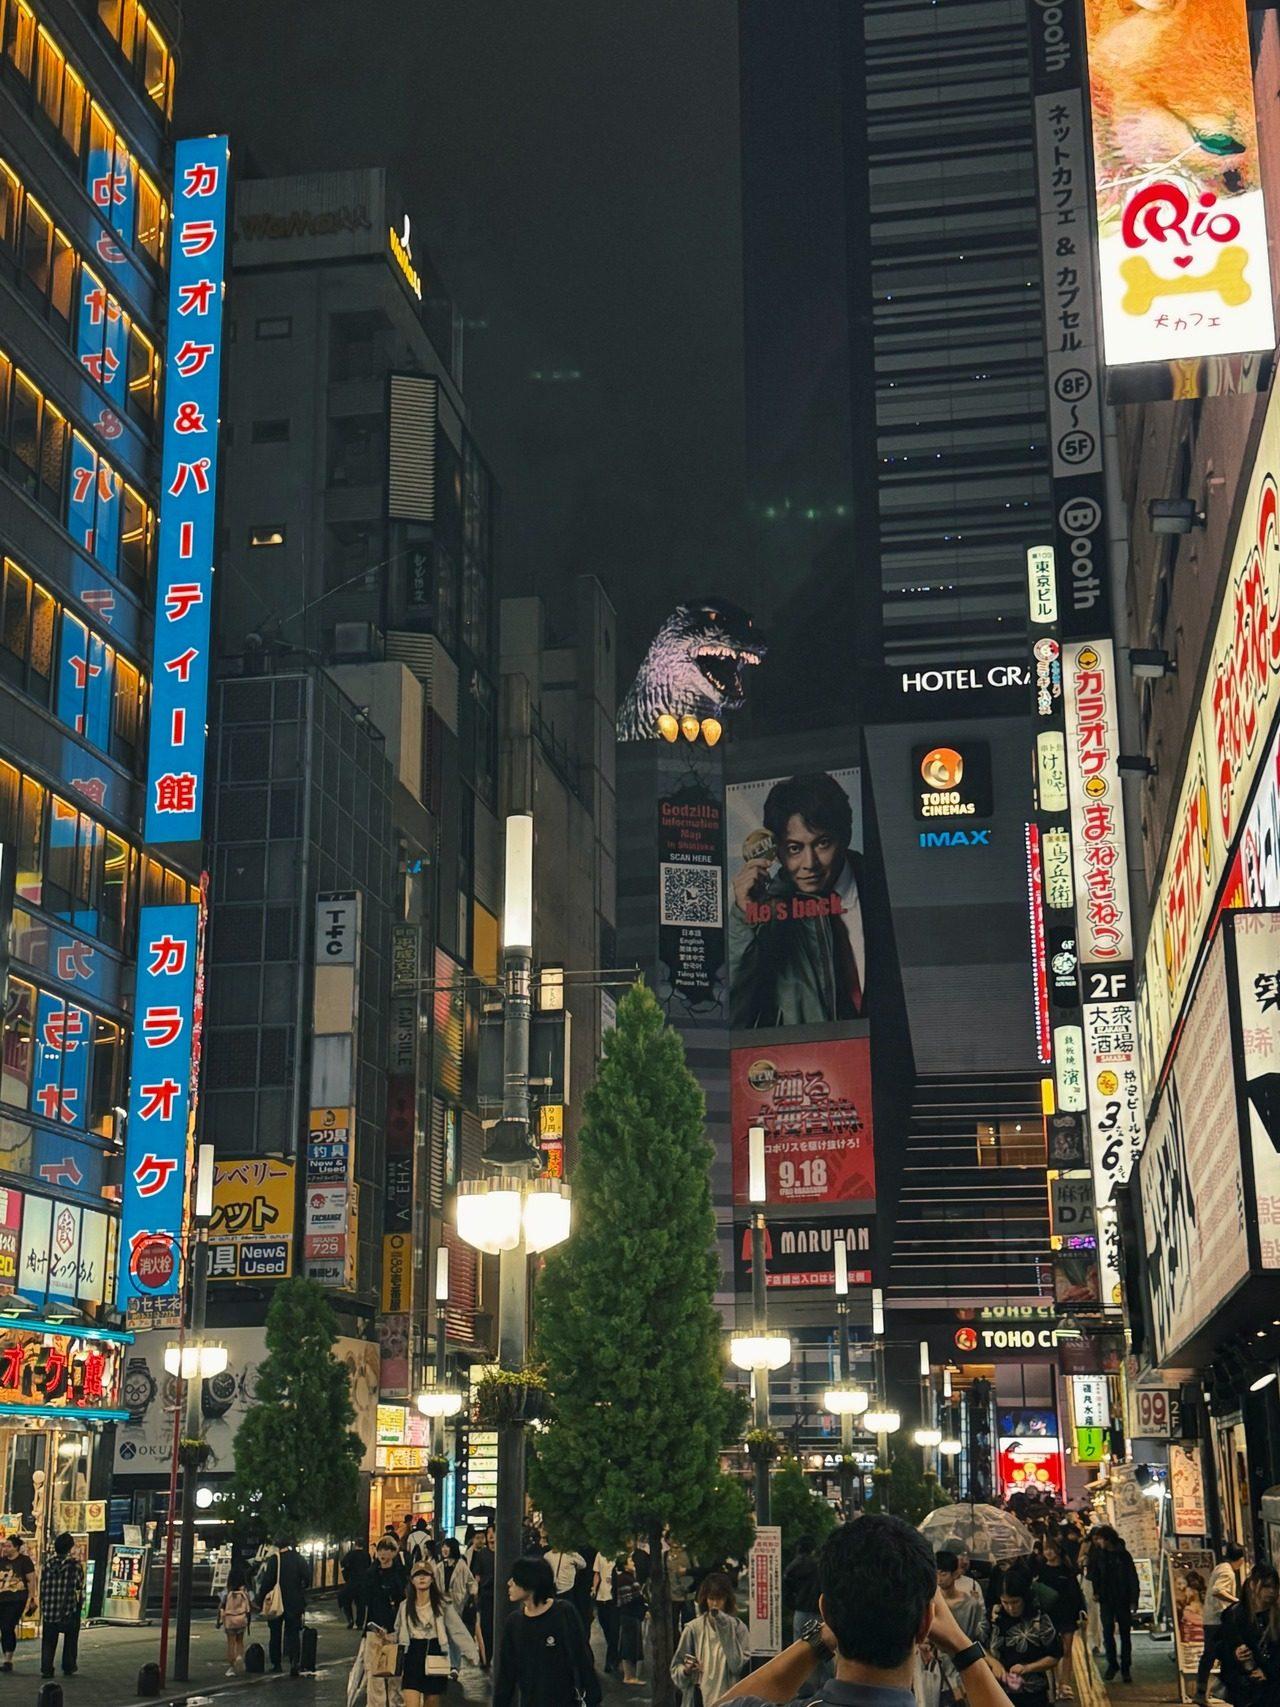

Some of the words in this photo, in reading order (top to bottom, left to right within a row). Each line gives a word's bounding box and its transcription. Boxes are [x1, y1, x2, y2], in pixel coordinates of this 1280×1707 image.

[1036, 0, 1071, 72] ooth
[1048, 104, 1076, 226] ネットカフェ
[1121, 183, 1240, 248] Rio
[1056, 267, 1082, 352] カプセル
[1154, 312, 1222, 331] 犬カフェ
[155, 162, 219, 813] カラオケ&パーティー館
[1059, 496, 1101, 610] Booth
[1035, 561, 1052, 616] 東京ビル
[902, 668, 983, 692] HOTEL
[1073, 669, 1111, 777] カラオケ
[921, 792, 960, 805] TOHO
[662, 802, 719, 818] Godzilla
[921, 803, 975, 817] CINEMAS
[918, 830, 989, 847] IMAX
[670, 853, 690, 861] SCAN
[692, 855, 712, 863] HERE
[1083, 802, 1125, 960] まねきねこ
[1061, 940, 1075, 950] 6F
[1090, 973, 1127, 998] 2F
[1089, 1005, 1132, 1026] 大衆
[1091, 1033, 1135, 1055] 酒場
[129, 934, 189, 1276] カラオケ
[310, 1129, 348, 1144] つり具
[319, 1165, 346, 1173] Used
[779, 1158, 827, 1188] 9.18
[311, 1213, 342, 1221] EXCHANGE
[242, 1246, 286, 1259] New&
[312, 1243, 338, 1255] 729
[139, 1256, 171, 1275] 消火栓
[244, 1261, 285, 1274] Used
[982, 1330, 1035, 1348] TOHO
[1038, 1330, 1058, 1348] CI
[1170, 1401, 1180, 1428] 2F
